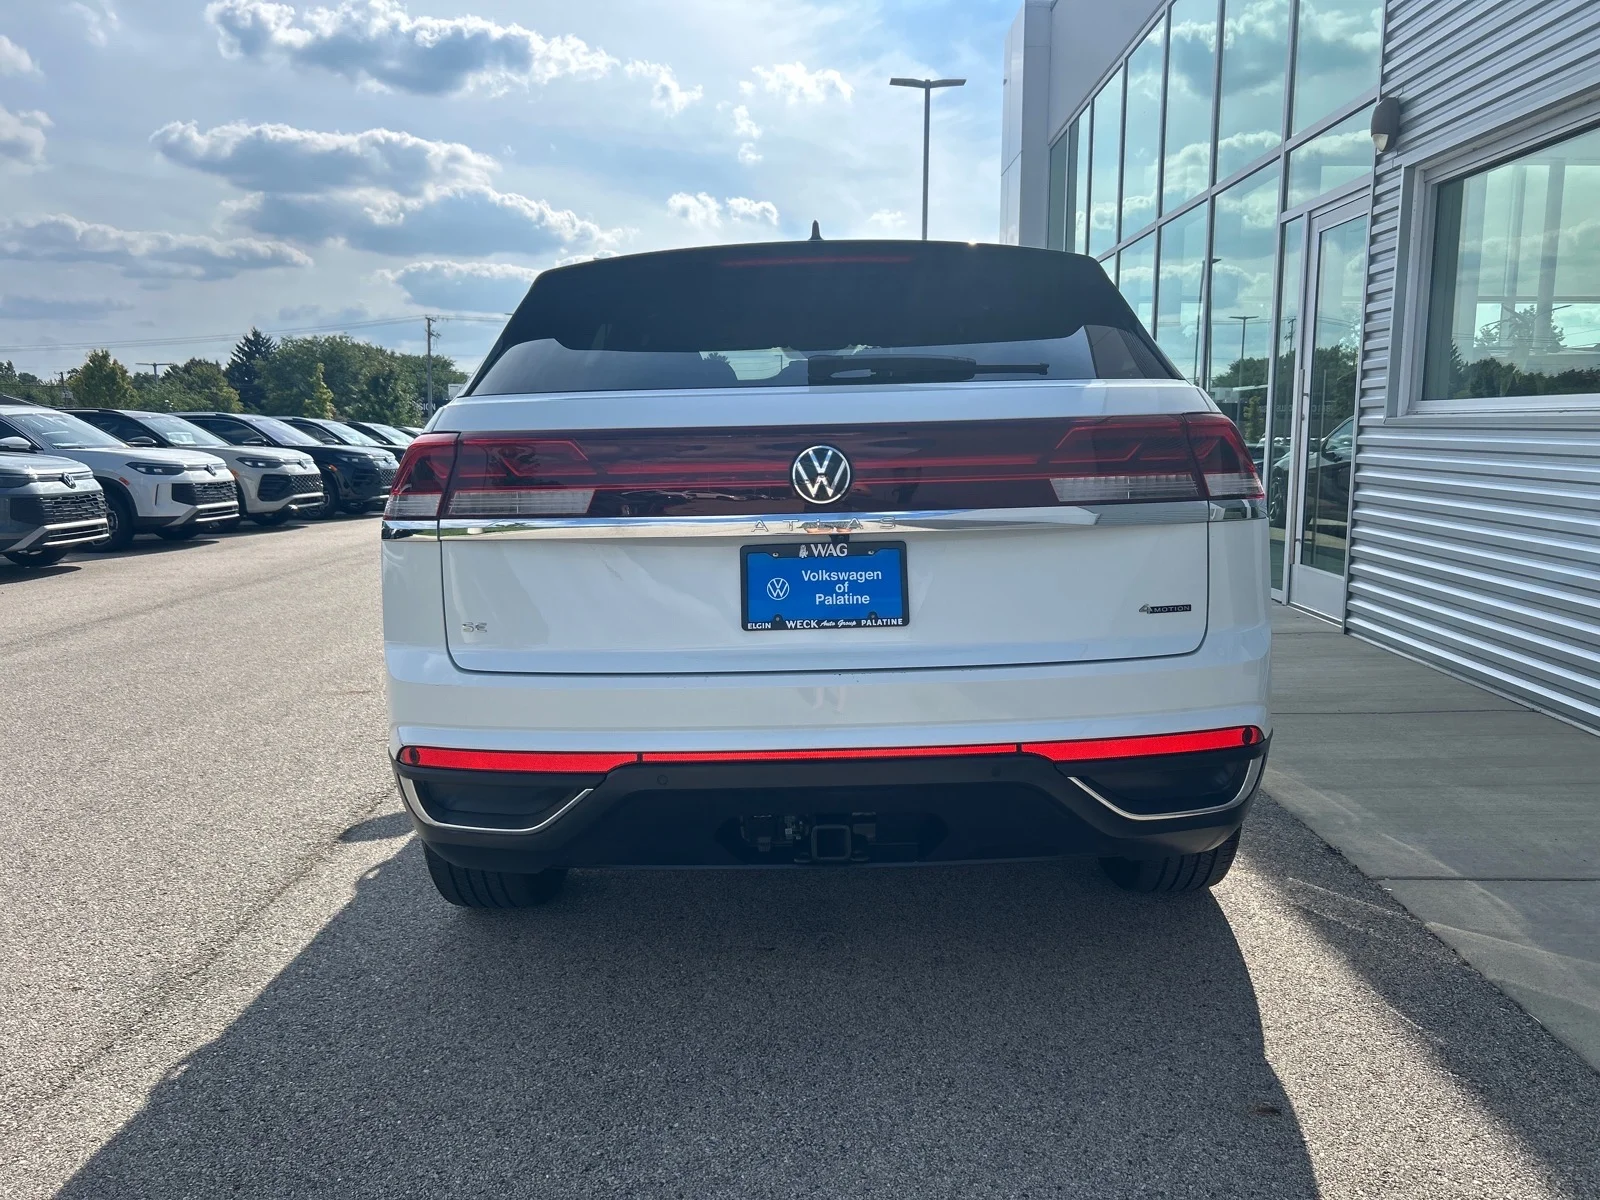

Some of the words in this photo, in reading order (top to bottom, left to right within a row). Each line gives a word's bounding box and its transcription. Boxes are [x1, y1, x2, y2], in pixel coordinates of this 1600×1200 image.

[751, 516, 897, 533] ATLAS
[810, 543, 848, 557] WAG
[801, 570, 882, 584] Volkswagen
[835, 582, 849, 593] of
[815, 593, 871, 605] Palatine
[1139, 603, 1191, 614] 4MOTION
[747, 622, 771, 630] ELGIN
[785, 619, 819, 629] WECK
[819, 619, 836, 627] Auto
[837, 619, 857, 628] Group
[861, 618, 903, 627] PALATINE
